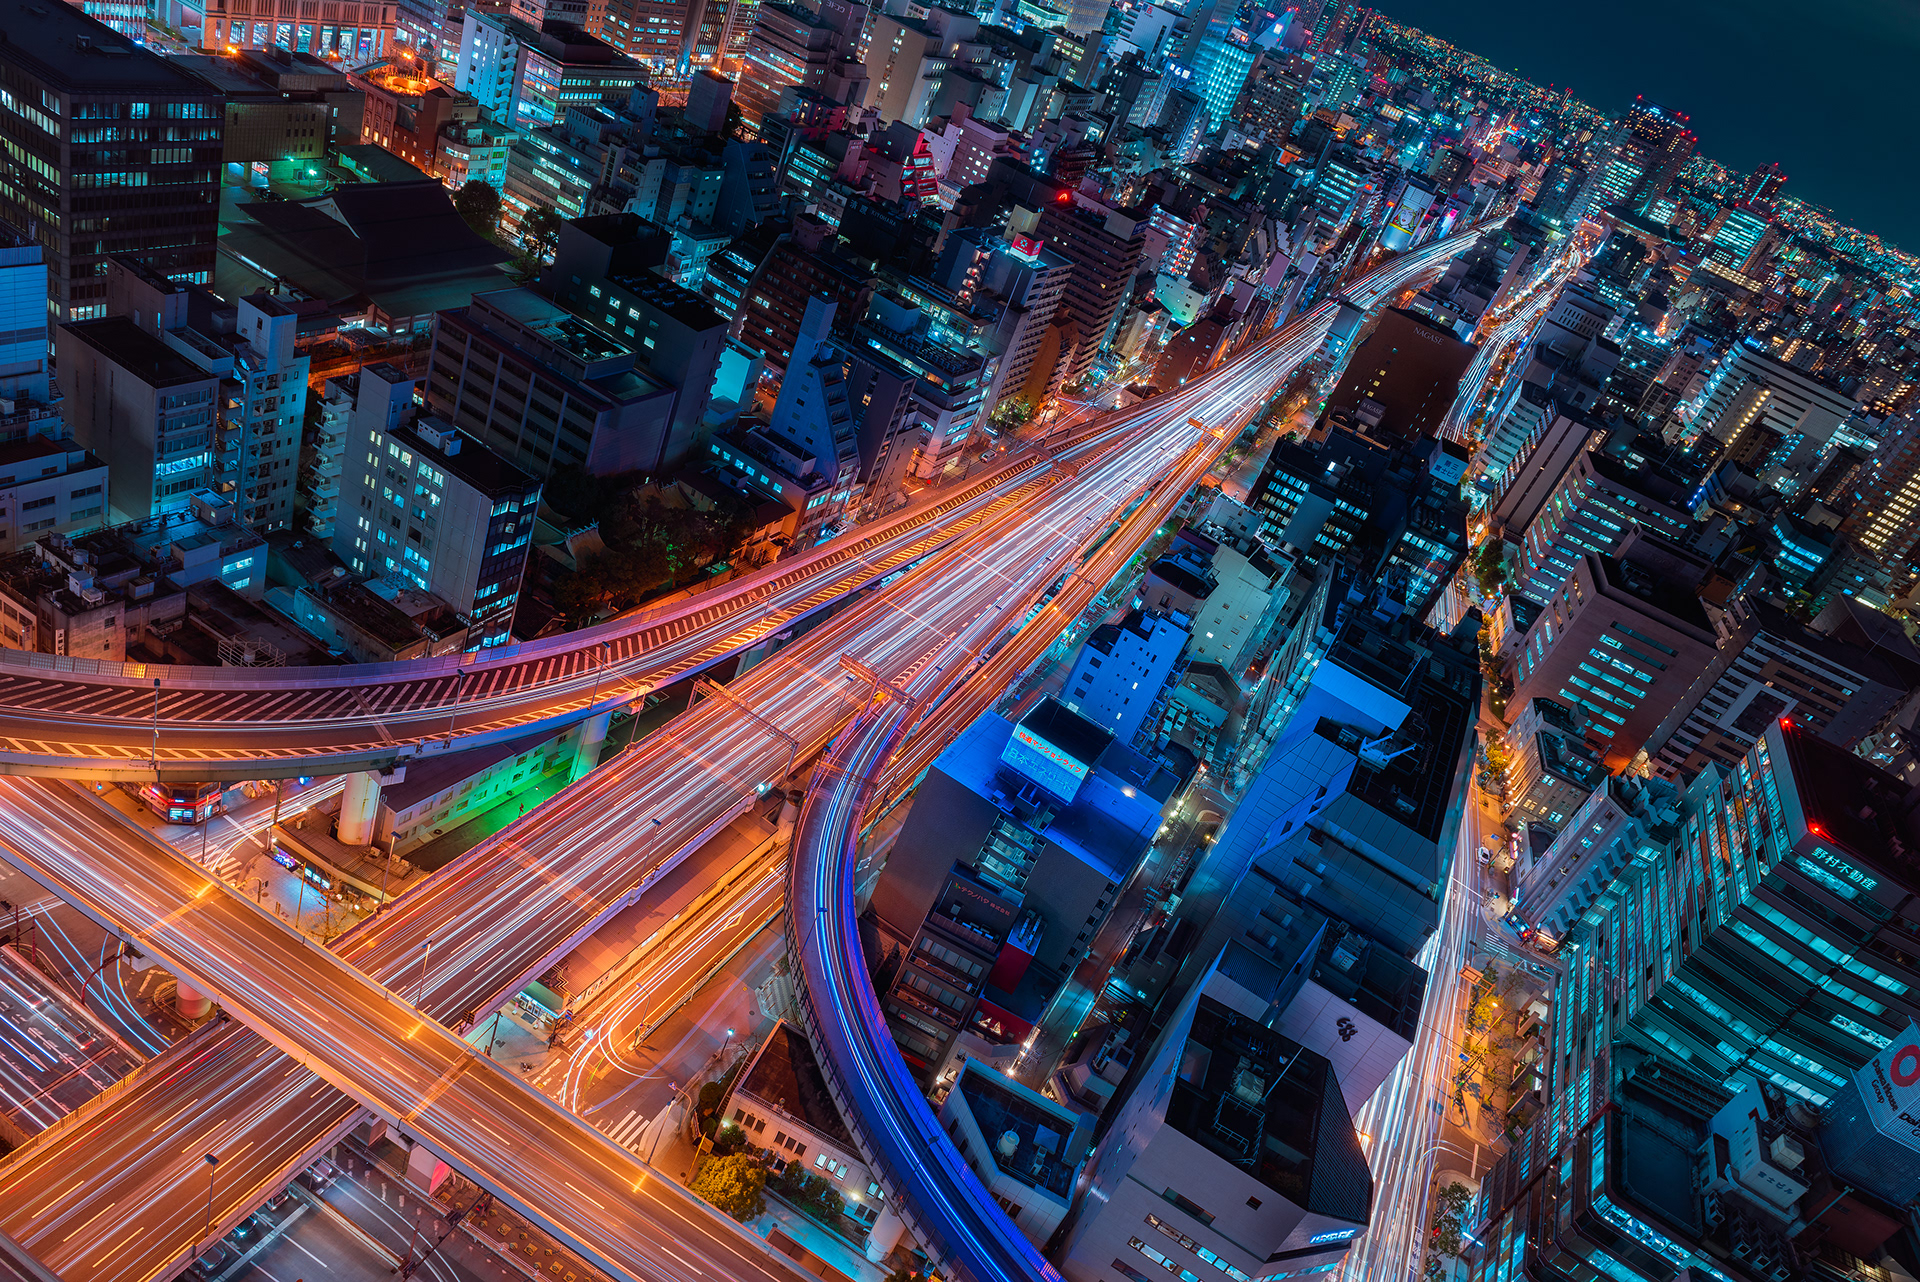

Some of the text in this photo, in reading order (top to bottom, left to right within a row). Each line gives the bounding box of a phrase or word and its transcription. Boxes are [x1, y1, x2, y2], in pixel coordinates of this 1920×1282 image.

[871, 210, 897, 227] KIYOHARA
[1414, 327, 1444, 345] NAGASE
[1361, 402, 1383, 416] NAGASE
[1434, 464, 1460, 480] 富士ビル
[1019, 731, 1082, 773] 快適マンションライフ
[1008, 747, 1073, 791] 日本エスリード
[1811, 846, 1878, 890] 野村不動産
[1871, 1079, 1884, 1104] Group
[1872, 1059, 1899, 1112] Daiwa House
[1757, 1171, 1794, 1195] 富士ビル
